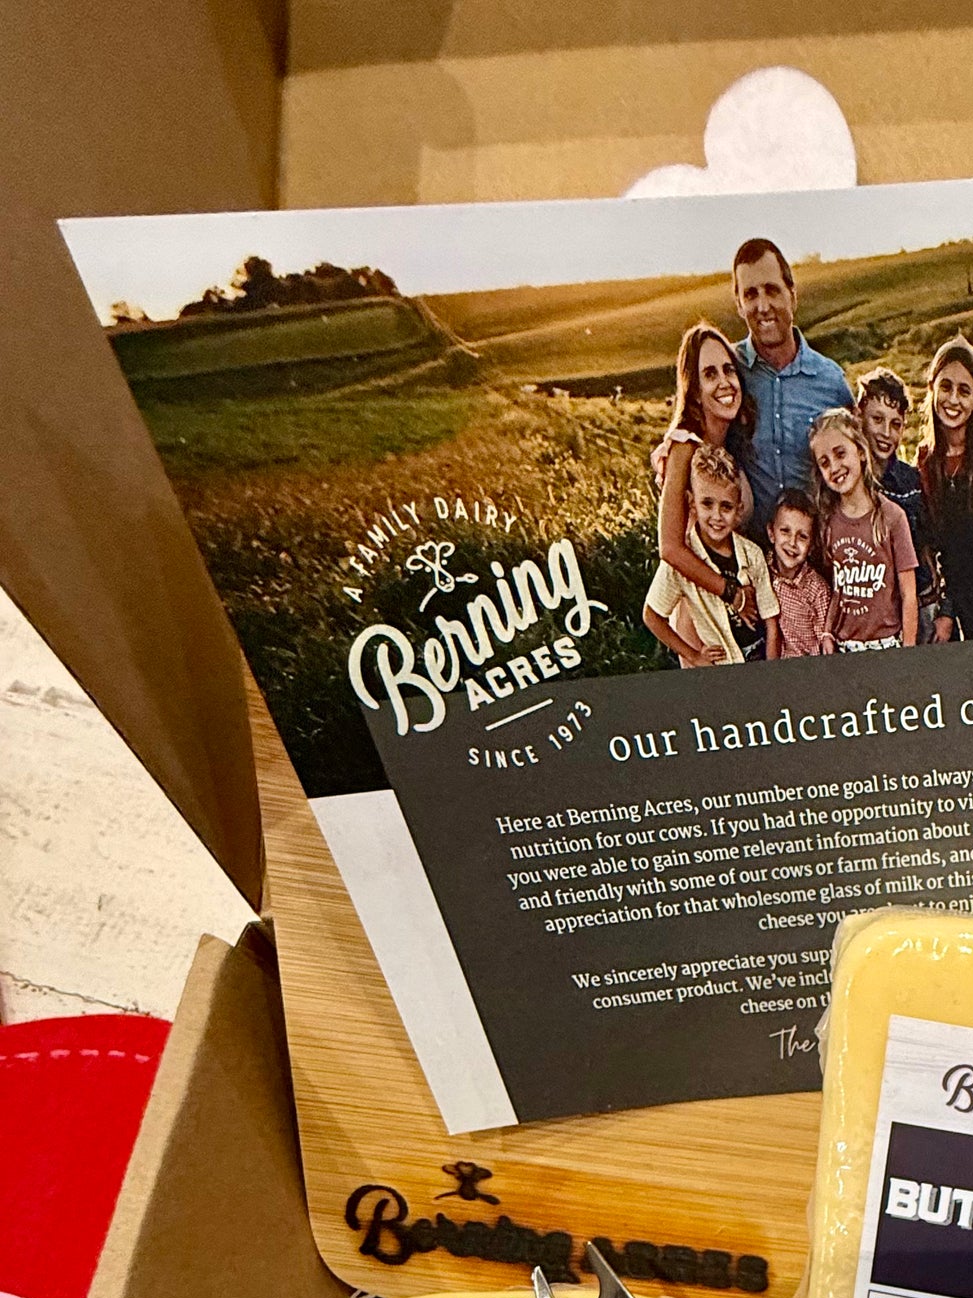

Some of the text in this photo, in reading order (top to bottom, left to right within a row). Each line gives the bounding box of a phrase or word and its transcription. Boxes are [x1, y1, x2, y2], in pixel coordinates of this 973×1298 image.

[344, 497, 516, 604] A FAMILY DAIRY
[348, 538, 609, 737] Berning
[464, 637, 582, 711] ACRES
[469, 700, 593, 769] SINCE 1973
[609, 730, 678, 761] our
[690, 694, 946, 752] handcrafted
[495, 816, 543, 834] Here
[545, 813, 566, 829] at
[566, 803, 642, 826] Berning
[644, 798, 700, 817] Acres,
[701, 794, 732, 810] our
[734, 784, 804, 807] number
[806, 783, 840, 799] one
[842, 774, 880, 800] goal
[882, 773, 899, 792] is
[901, 774, 920, 790] to
[510, 836, 593, 860] nutrition
[595, 831, 623, 849] for
[625, 829, 656, 846] our
[658, 824, 708, 842] cows.
[710, 817, 726, 836] If
[727, 818, 761, 838] you
[762, 810, 796, 830] had
[798, 808, 828, 826] the
[831, 797, 934, 827] opportunity
[937, 798, 955, 813] to
[506, 870, 542, 891] you
[542, 864, 588, 881] were
[590, 856, 628, 876] able
[630, 856, 649, 871] to
[652, 849, 691, 873] gain
[693, 846, 740, 864] some
[742, 837, 814, 858] relevant
[816, 825, 919, 850] information
[922, 821, 971, 840] about
[544, 905, 653, 935] appreciation
[655, 901, 681, 918] for
[683, 897, 720, 915] that
[721, 888, 817, 910] wholesome
[819, 882, 862, 904] glass
[864, 877, 882, 896] of
[884, 874, 925, 894] milk
[926, 876, 945, 890] or
